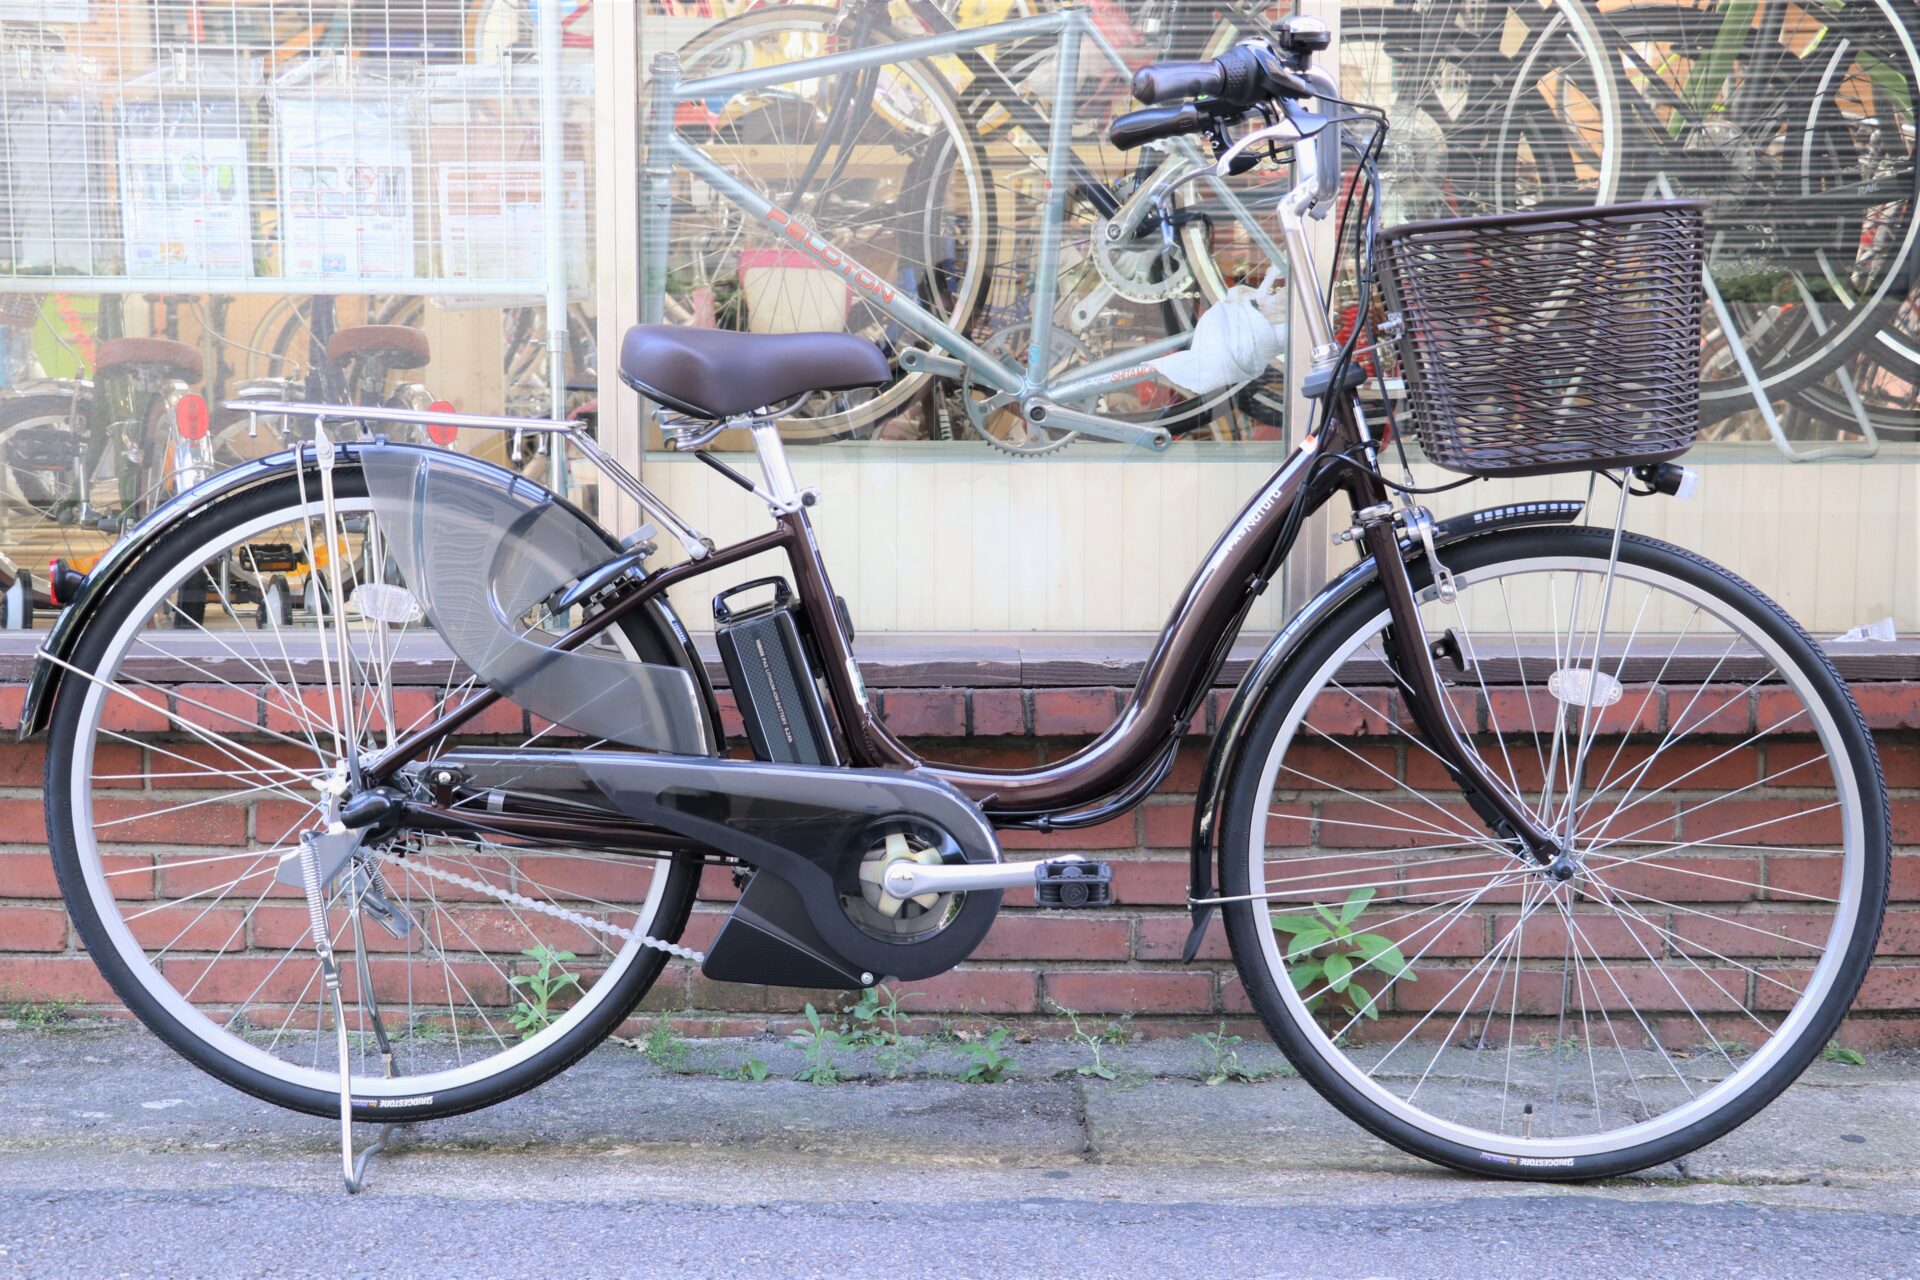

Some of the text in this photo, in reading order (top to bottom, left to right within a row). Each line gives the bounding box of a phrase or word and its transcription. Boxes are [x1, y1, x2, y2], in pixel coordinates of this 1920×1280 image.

[767, 207, 896, 304] PELOTON
[775, 701, 787, 725] BATTERY
[379, 1096, 434, 1108] BRIDGESTONE
[1519, 1157, 1574, 1167] BRIDGESTONE
